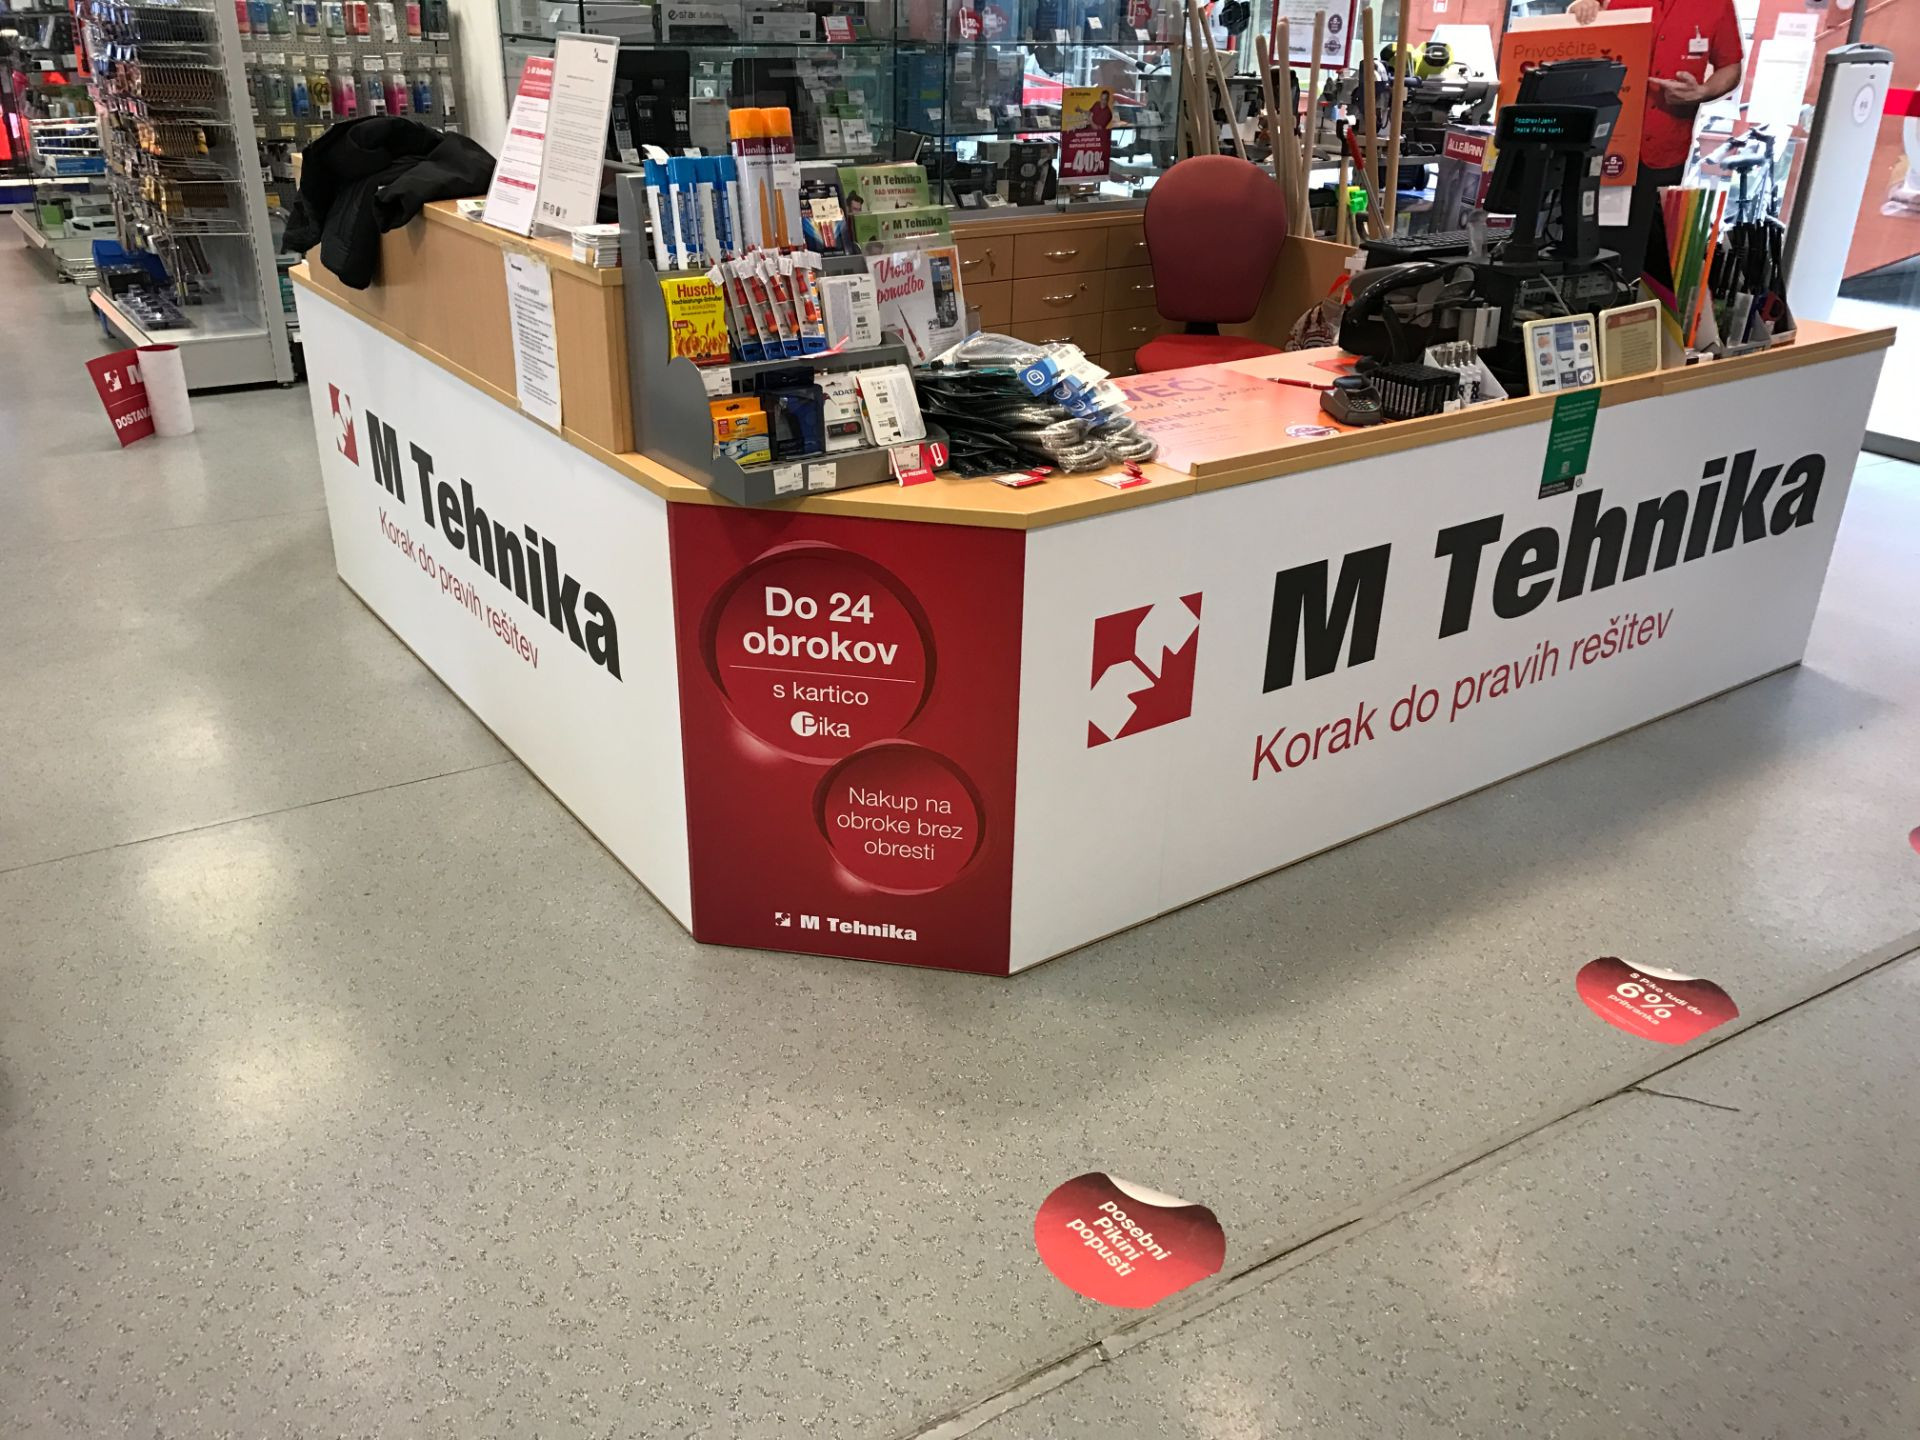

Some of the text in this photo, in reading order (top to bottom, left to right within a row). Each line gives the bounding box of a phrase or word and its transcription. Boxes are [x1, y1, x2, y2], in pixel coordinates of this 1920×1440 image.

[1513, 41, 1598, 60] Privoščite
[1064, 150, 1105, 173] -40%
[872, 174, 922, 185] M Tehnika
[892, 217, 943, 230] M Tehnika
[873, 257, 914, 284] Vroča
[677, 281, 715, 298] Husch
[876, 275, 925, 304] ponudba
[366, 409, 623, 683] M Tehnika
[1262, 448, 1826, 694] M Tehnika
[379, 506, 538, 669] Korak do pravih rešitev
[765, 586, 874, 624] Do 24
[742, 626, 898, 666] obrokov
[772, 682, 869, 706] s kartico
[1252, 608, 1674, 781] Korak do pravih rešitev
[848, 787, 952, 815] Nakup na
[836, 812, 964, 840] obroke brez
[864, 838, 936, 861] obresti
[800, 914, 918, 942] M Tehnika
[1616, 982, 1676, 1019] 6%
[1092, 1216, 1145, 1261] Pikini
[1098, 1200, 1172, 1261] posebni
[1066, 1218, 1136, 1278] popusti
